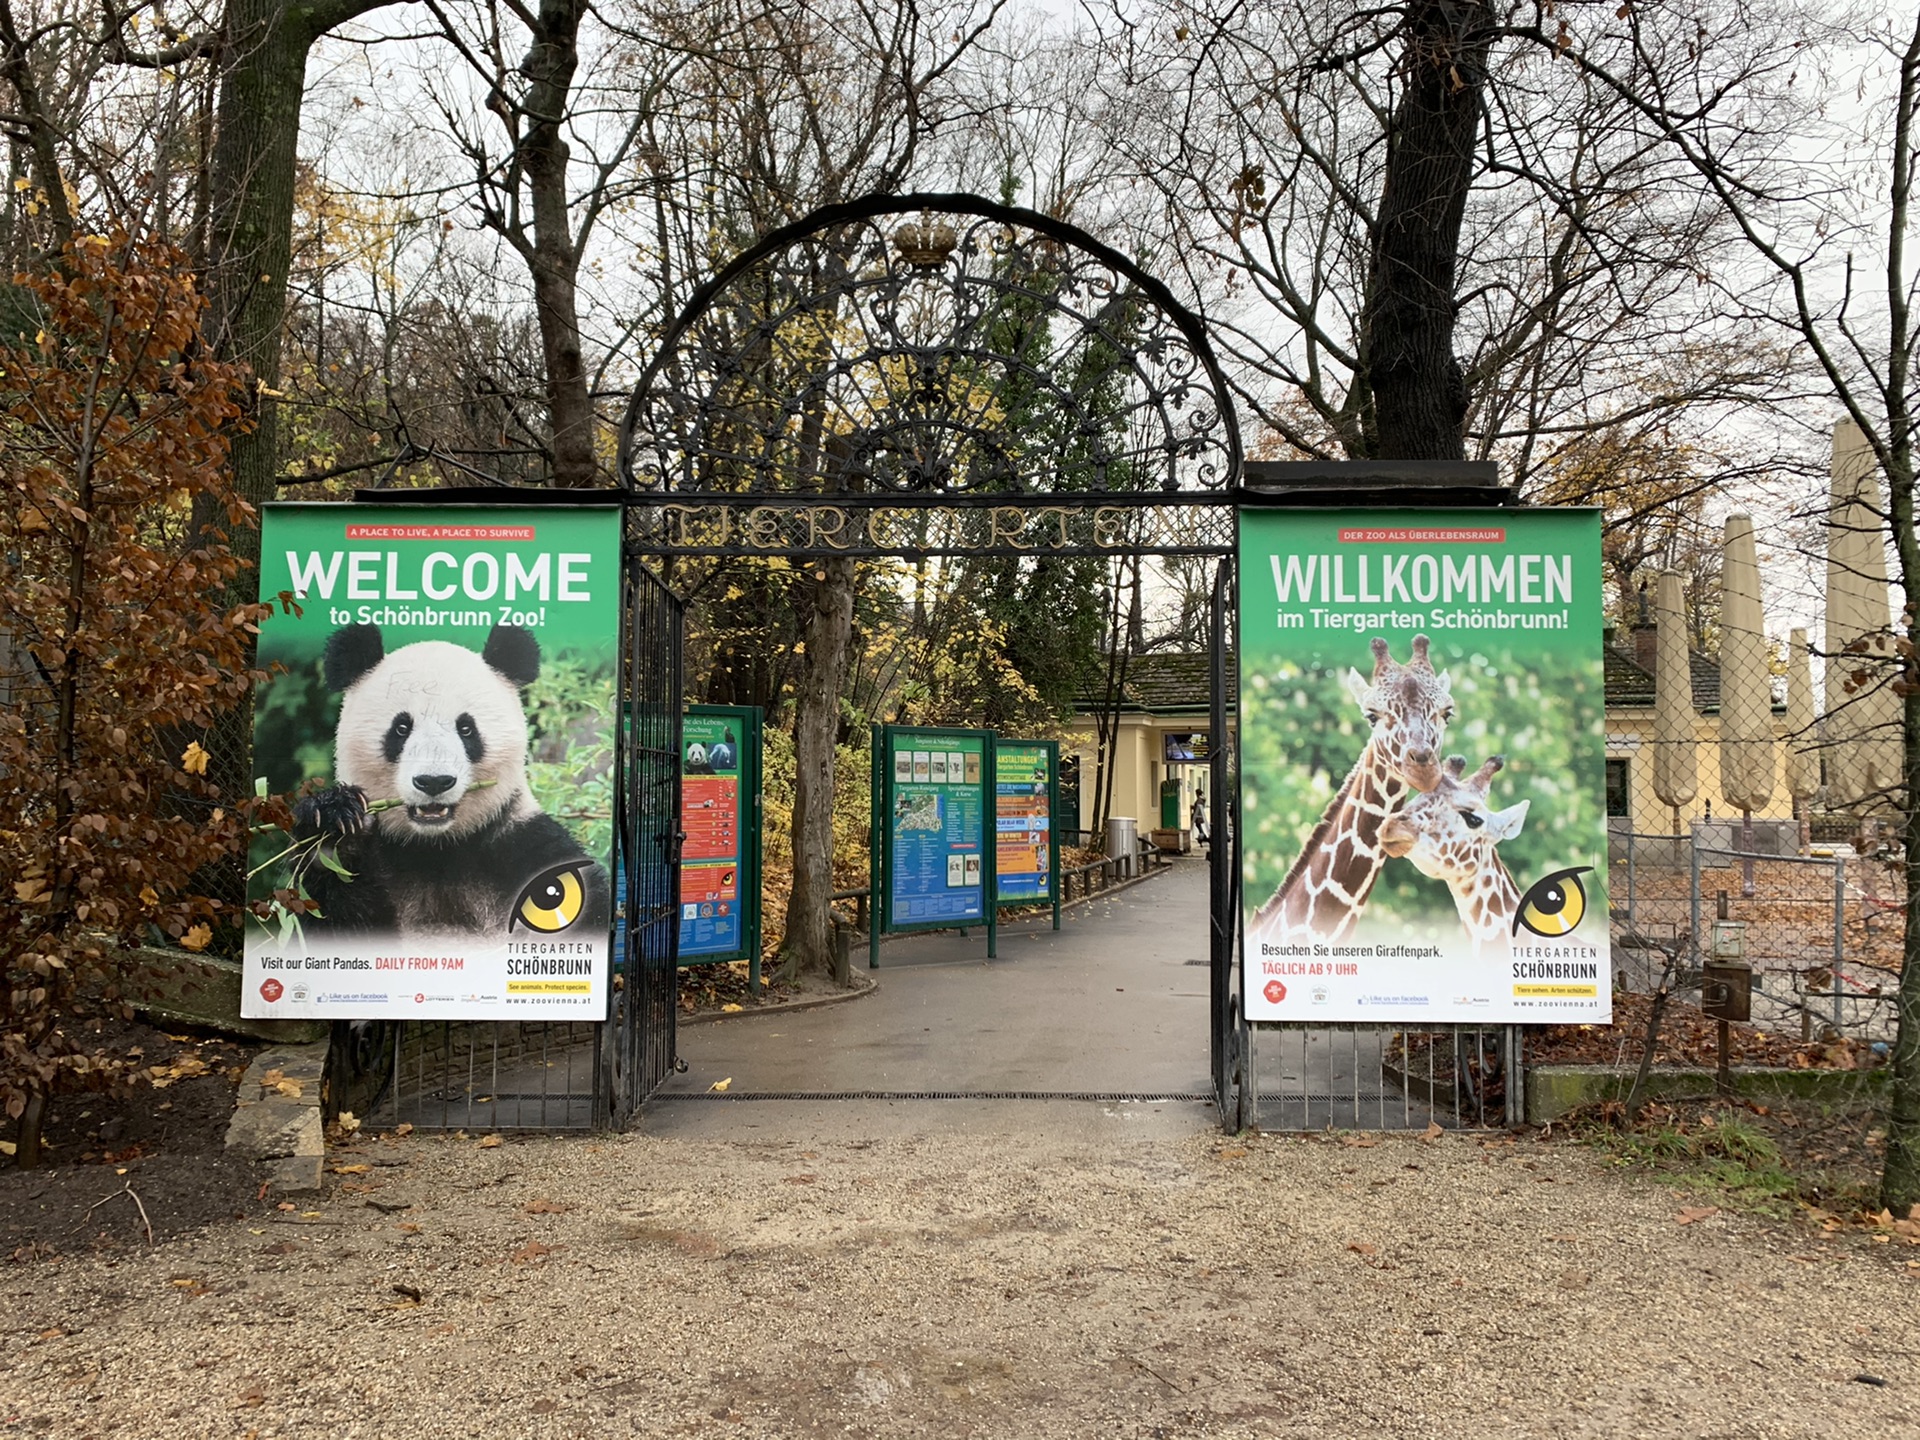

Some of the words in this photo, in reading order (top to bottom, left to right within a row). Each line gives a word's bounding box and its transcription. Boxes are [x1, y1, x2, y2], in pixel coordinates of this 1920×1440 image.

[350, 527, 358, 537] A
[359, 527, 389, 537] PLACE
[391, 528, 404, 537] TO
[406, 528, 431, 538] LIVE,
[432, 528, 441, 537] A
[442, 528, 471, 538] PLACE
[474, 529, 487, 538] TO
[489, 529, 530, 538] SURVIVE
[661, 503, 1201, 552] TIERGARTEN
[1344, 531, 1364, 540] DER
[1366, 531, 1386, 540] ZOO
[1388, 531, 1407, 540] ALS
[1408, 529, 1499, 540] ÜBERLEBENSRAUM
[285, 551, 592, 602] WELCOME
[1269, 554, 1573, 603] WILLKOMMEN
[329, 606, 351, 626] to
[356, 605, 492, 626] Schönbrunn
[497, 606, 545, 627] Zoo!
[1277, 608, 1305, 628] im
[1309, 608, 1425, 633] Tiergarten
[1430, 608, 1569, 629] Schönbrunn!
[507, 942, 593, 954] TIERGARTEN
[1261, 943, 1311, 957] Besuchen
[1313, 944, 1329, 957] Sie
[1332, 946, 1373, 957] unseren
[1375, 944, 1443, 960] Giraffenpark.
[1512, 947, 1598, 958] TIERGARTEN
[261, 956, 284, 970] Visit
[285, 959, 303, 970] our
[304, 956, 331, 970] Giant
[333, 956, 372, 970] Pandas.
[375, 957, 405, 971] DAILY
[407, 957, 438, 971] FROM
[440, 957, 464, 971] 9AM
[506, 955, 592, 976] SCHÖNBRUNN
[1261, 960, 1306, 975] TÄGLICH
[1308, 962, 1324, 976] AB
[1326, 963, 1333, 976] 9
[1335, 963, 1358, 976] UHR
[1512, 959, 1598, 979] SCHÖNBRUNN
[508, 983, 520, 991] See
[544, 983, 565, 991] Protect
[1517, 986, 1531, 994] Tiere
[505, 997, 591, 1005] www.zoovienna.at
[1513, 1000, 1599, 1008] www.zoovienna.at
